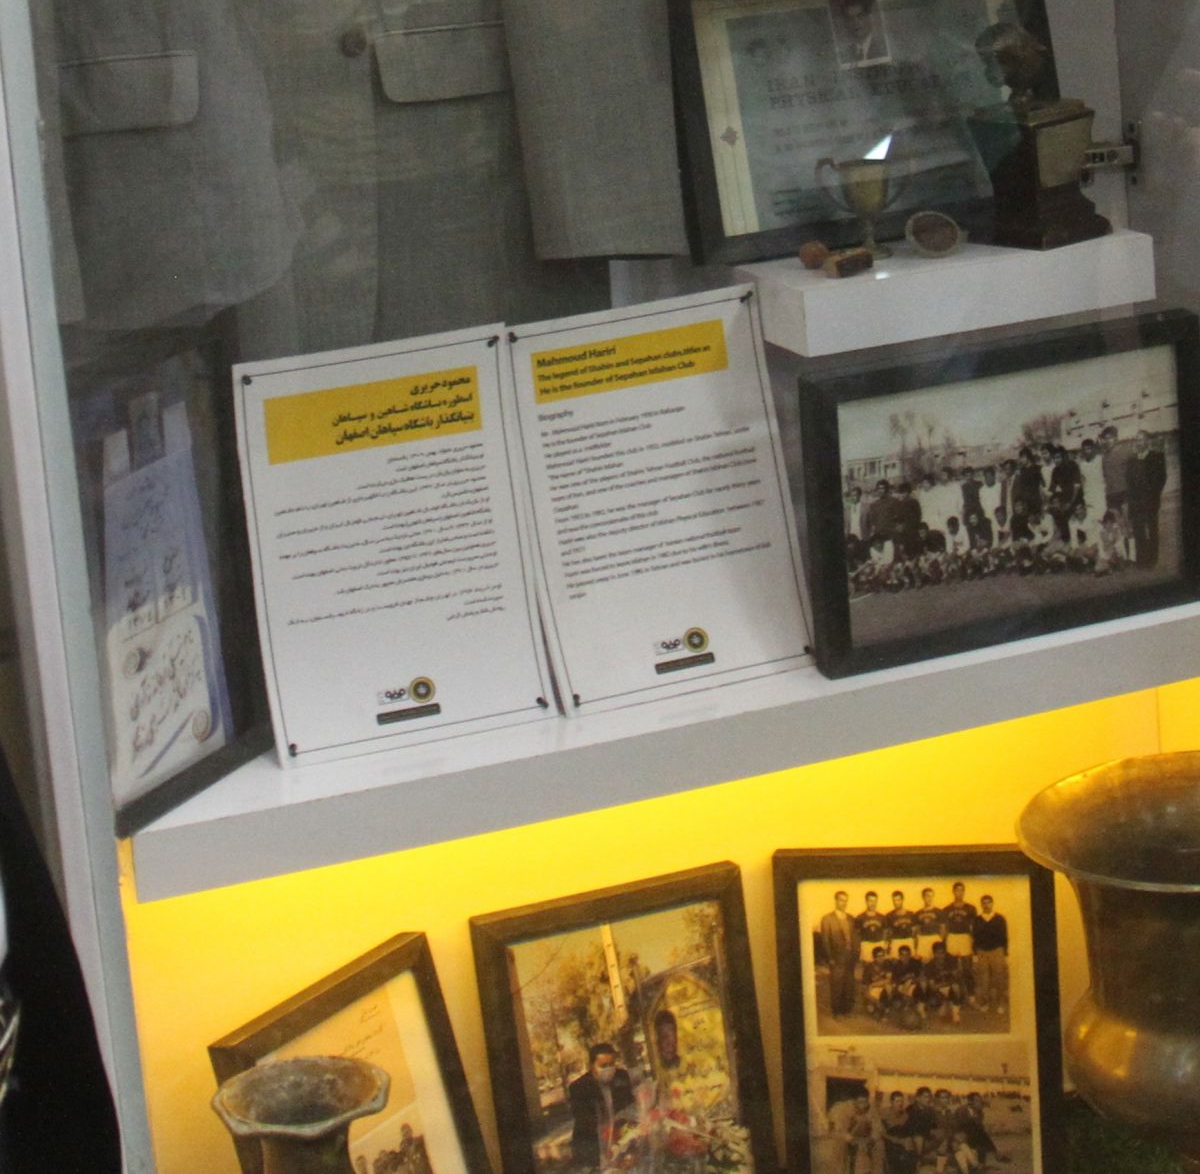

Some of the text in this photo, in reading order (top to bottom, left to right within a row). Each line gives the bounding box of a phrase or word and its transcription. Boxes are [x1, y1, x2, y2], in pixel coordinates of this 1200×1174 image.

[536, 346, 616, 368] Mahmoud Hariri
[538, 373, 551, 382] The
[615, 359, 629, 368] and
[560, 383, 572, 392] the
[573, 377, 603, 389] founder
[605, 375, 614, 383] of
[677, 360, 695, 370] Club
